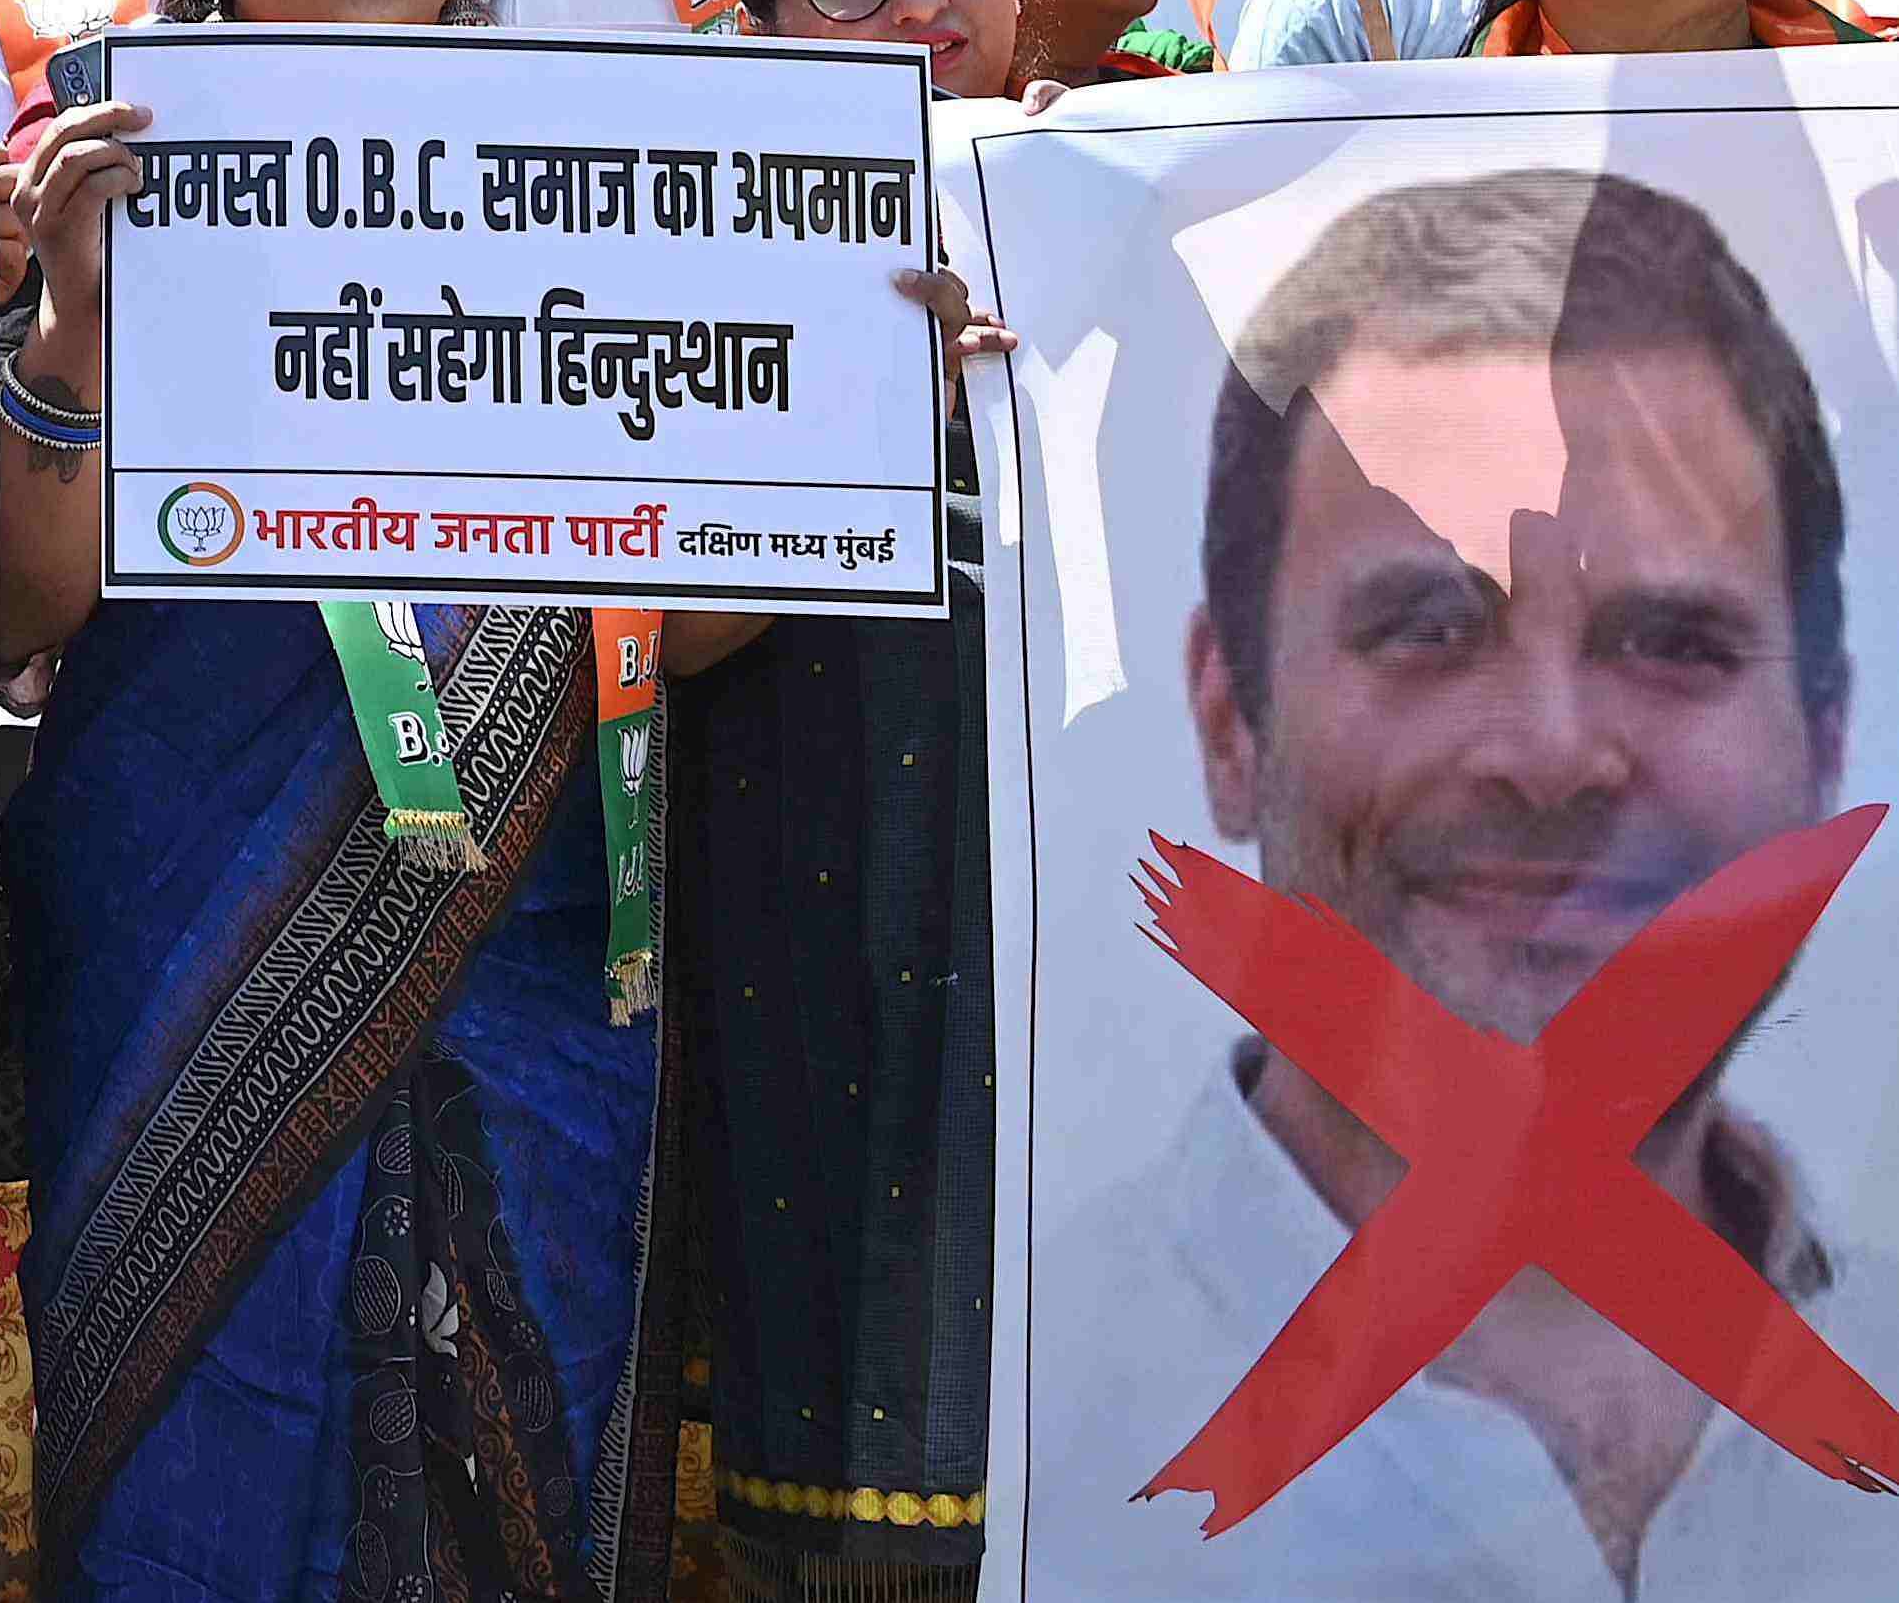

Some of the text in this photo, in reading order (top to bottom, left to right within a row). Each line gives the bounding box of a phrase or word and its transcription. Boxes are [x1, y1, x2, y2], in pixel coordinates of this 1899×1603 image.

[127, 138, 916, 246] समस्त O.B.C. समाज का अपमान
[269, 282, 794, 441] नहीं सहेगा हिन्दुस्थान
[254, 497, 896, 571] भारतीय जनता पार्टी दक्षिण मध्य मुंबई
